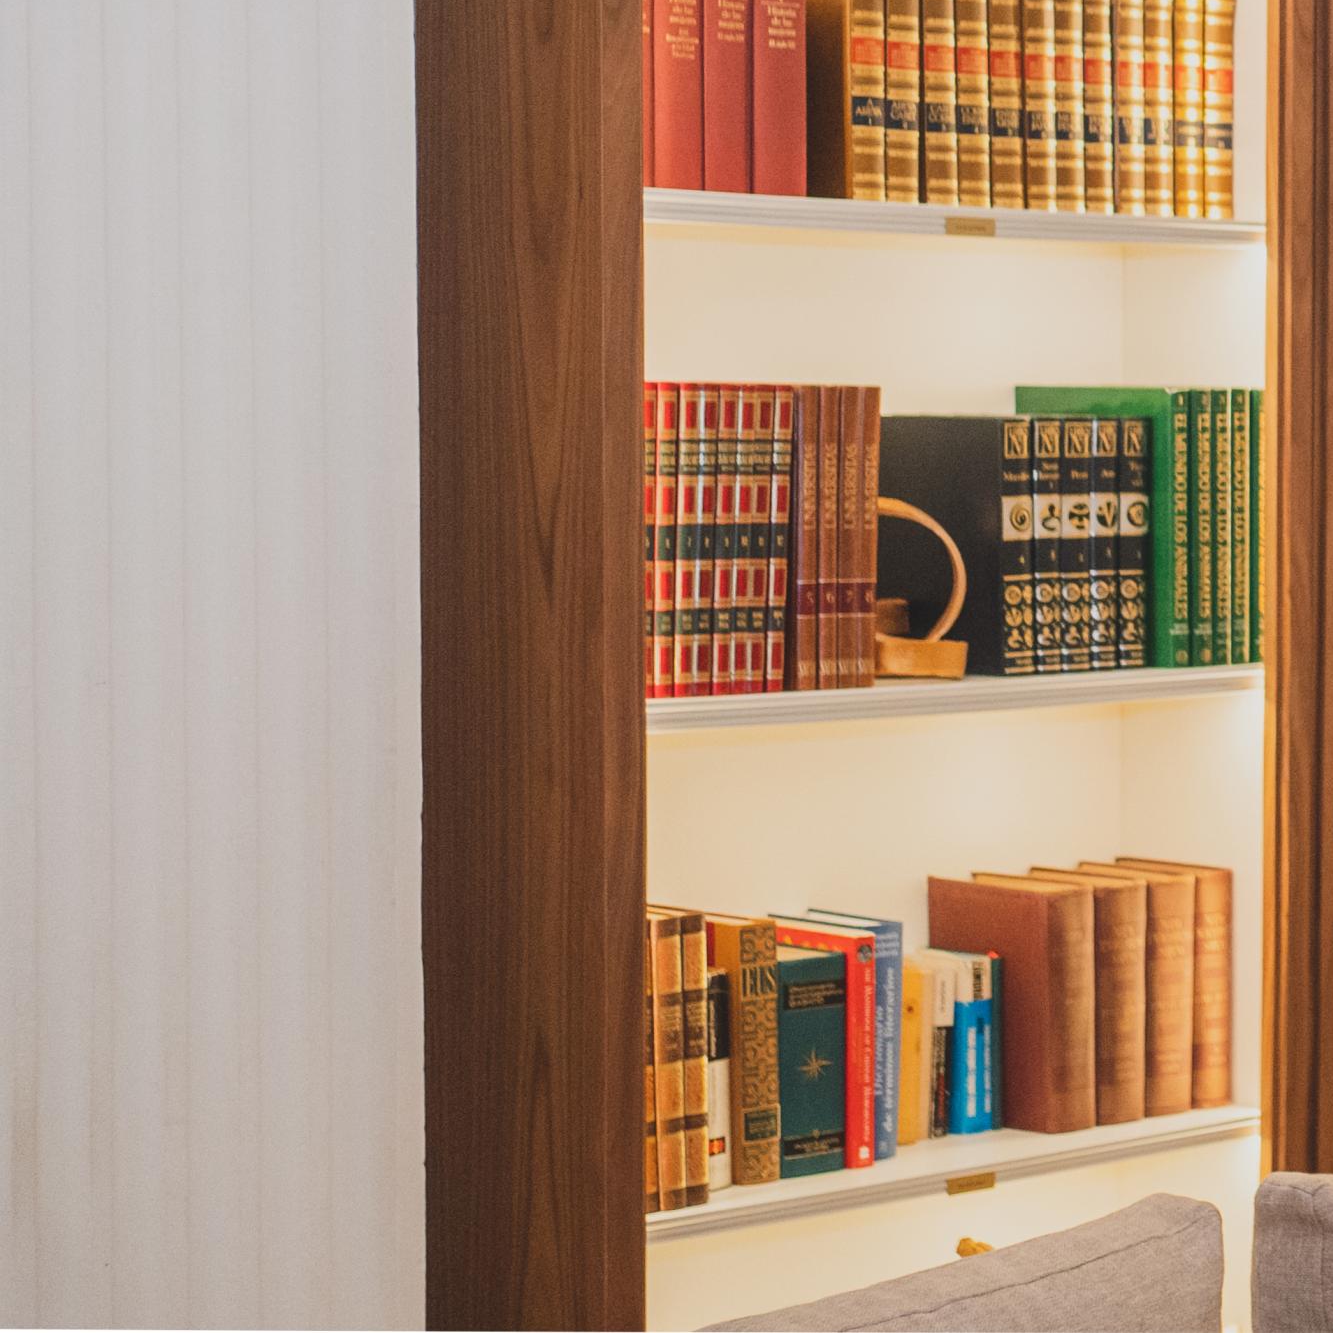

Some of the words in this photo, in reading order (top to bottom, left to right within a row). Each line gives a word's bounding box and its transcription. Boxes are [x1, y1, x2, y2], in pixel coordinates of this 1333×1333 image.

[1174, 413, 1187, 431] EL
[1174, 433, 1187, 491] MUNDO
[1174, 493, 1187, 513] DE
[1174, 515, 1187, 542] LOS
